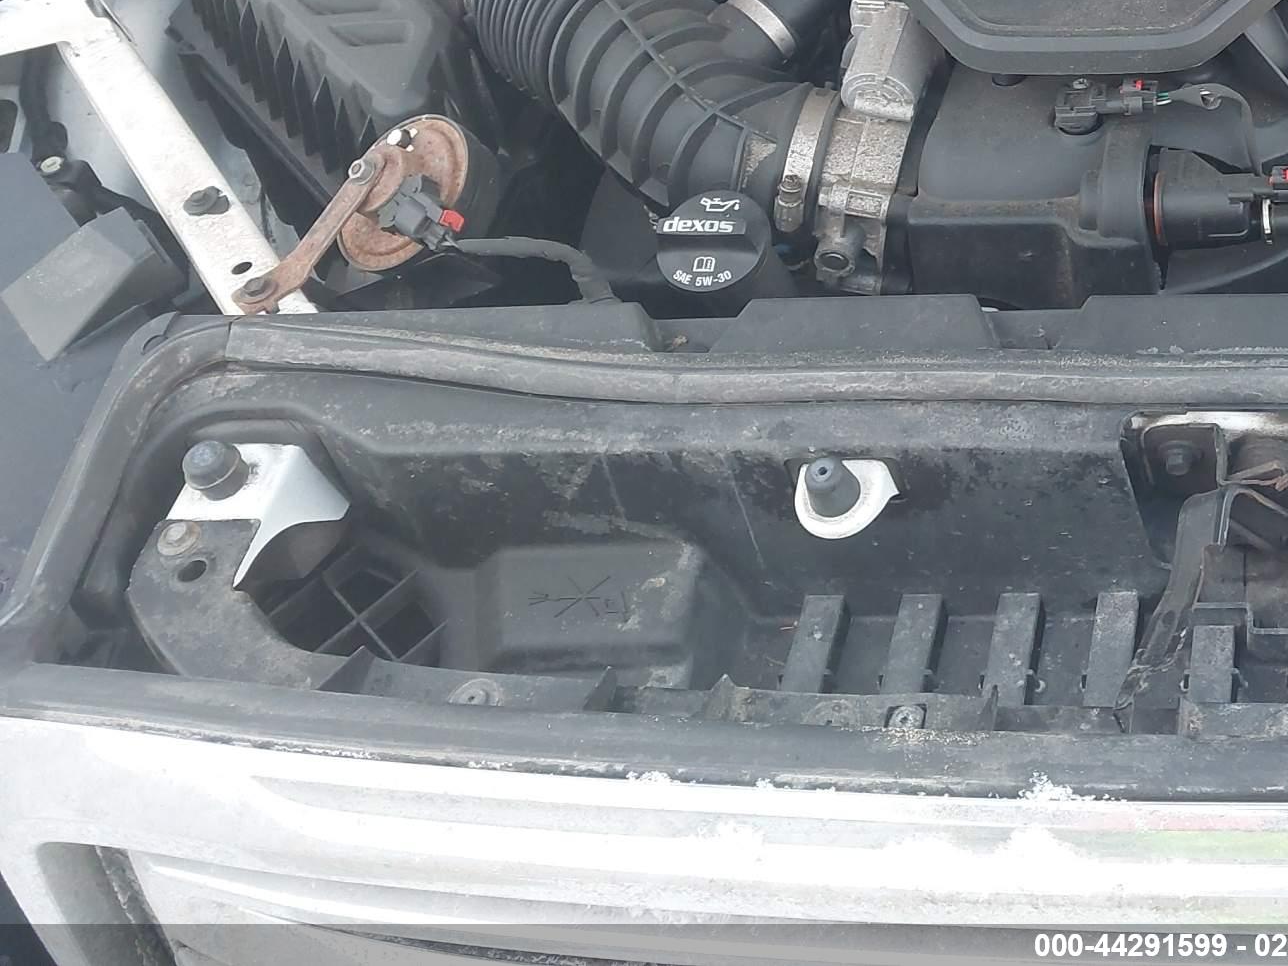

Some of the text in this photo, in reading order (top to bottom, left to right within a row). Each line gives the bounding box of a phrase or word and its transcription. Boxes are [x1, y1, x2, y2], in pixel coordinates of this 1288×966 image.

[662, 216, 736, 233] dexos
[673, 269, 732, 286] SAE 5W-30
